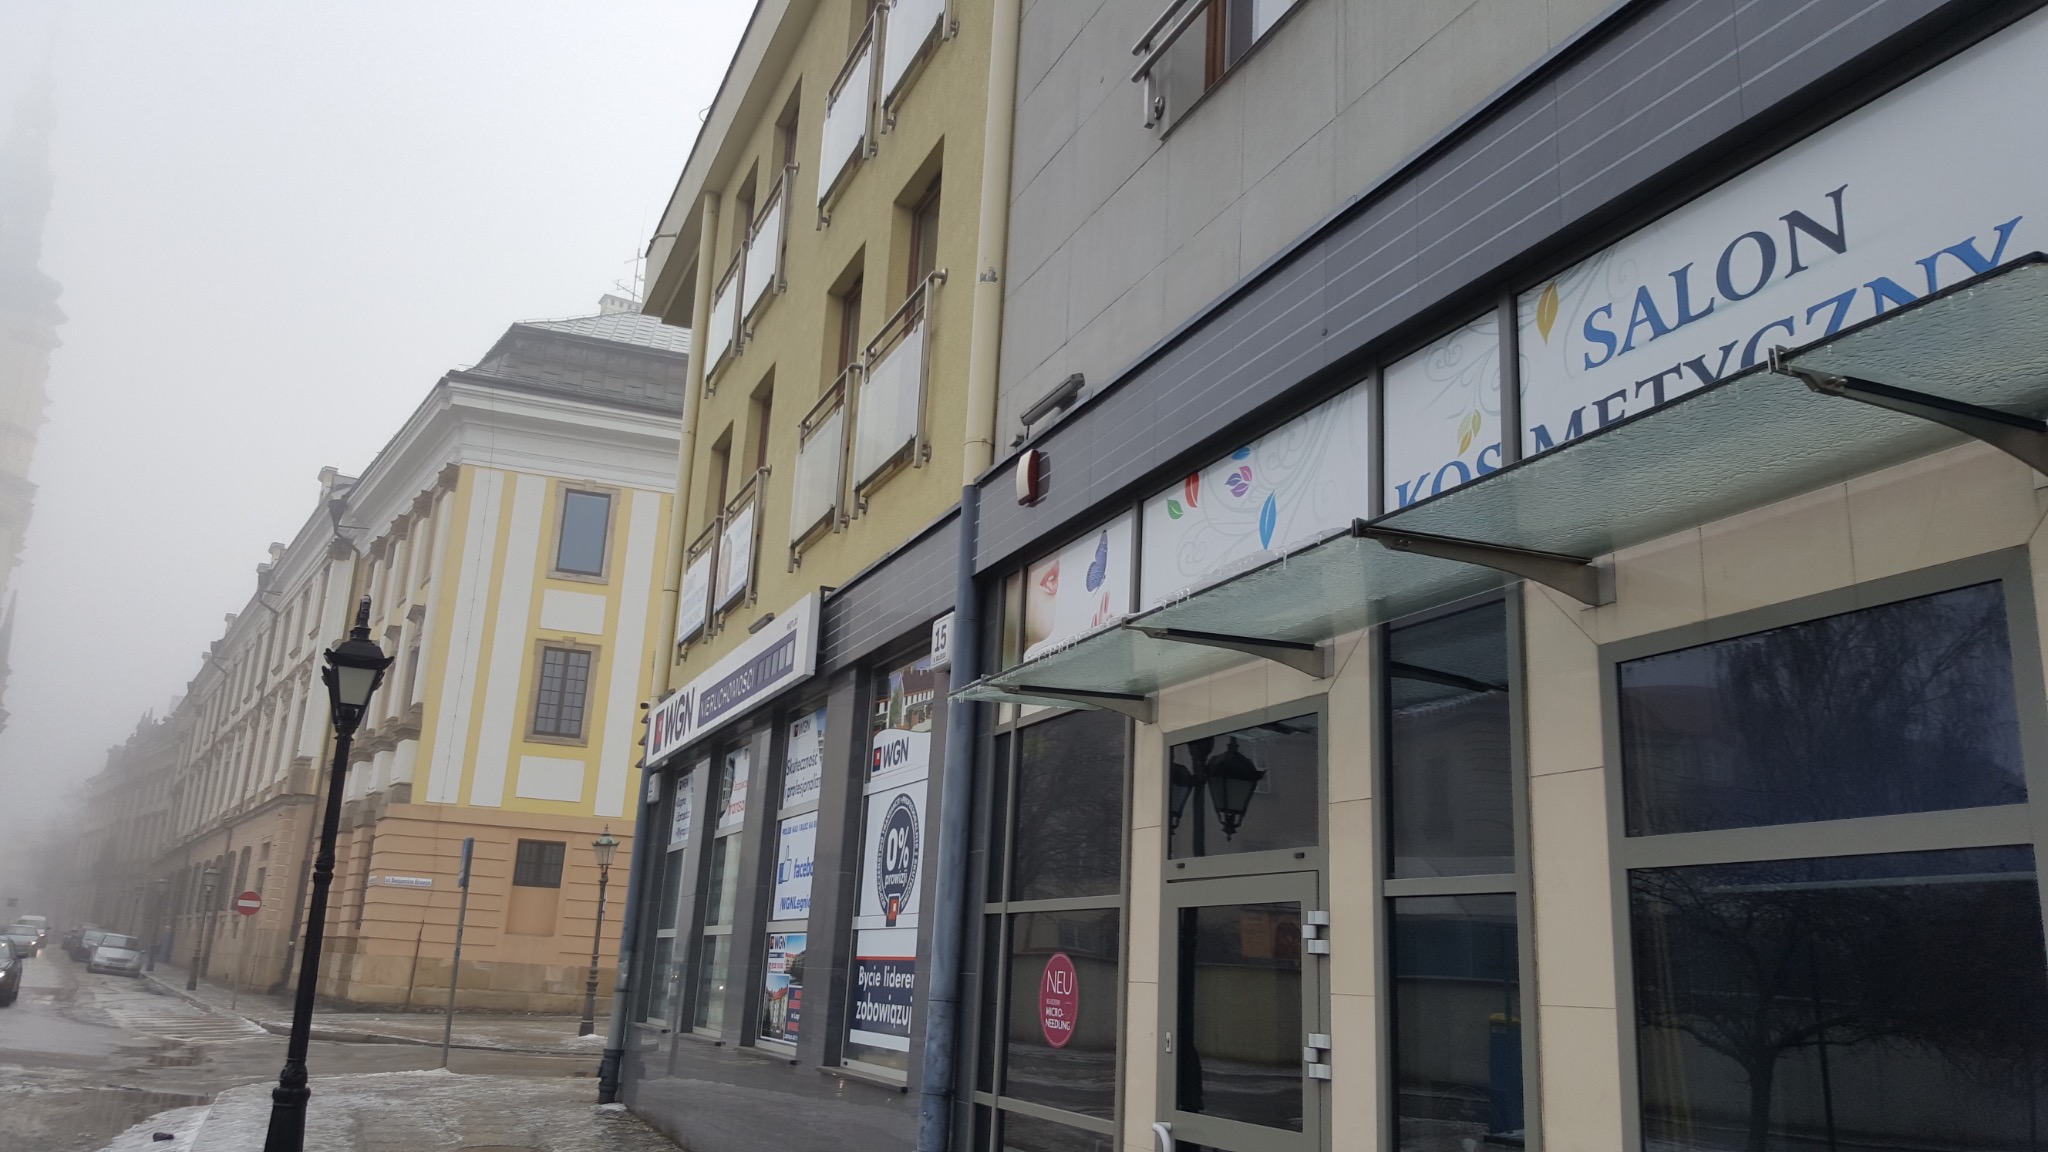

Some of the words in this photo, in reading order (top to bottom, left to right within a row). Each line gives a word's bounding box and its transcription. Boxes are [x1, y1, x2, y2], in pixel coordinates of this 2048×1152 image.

[1583, 184, 1849, 371] SALON
[934, 624, 947, 652] 15
[664, 687, 695, 748] WGN
[883, 736, 909, 769] WGN
[886, 826, 909, 871] 0%
[774, 936, 786, 949] WGN
[858, 965, 881, 991] Bycie
[1046, 970, 1073, 995] NEU
[1045, 1006, 1064, 1017] MICRO-
[1045, 1018, 1071, 1031] NEEDLING
